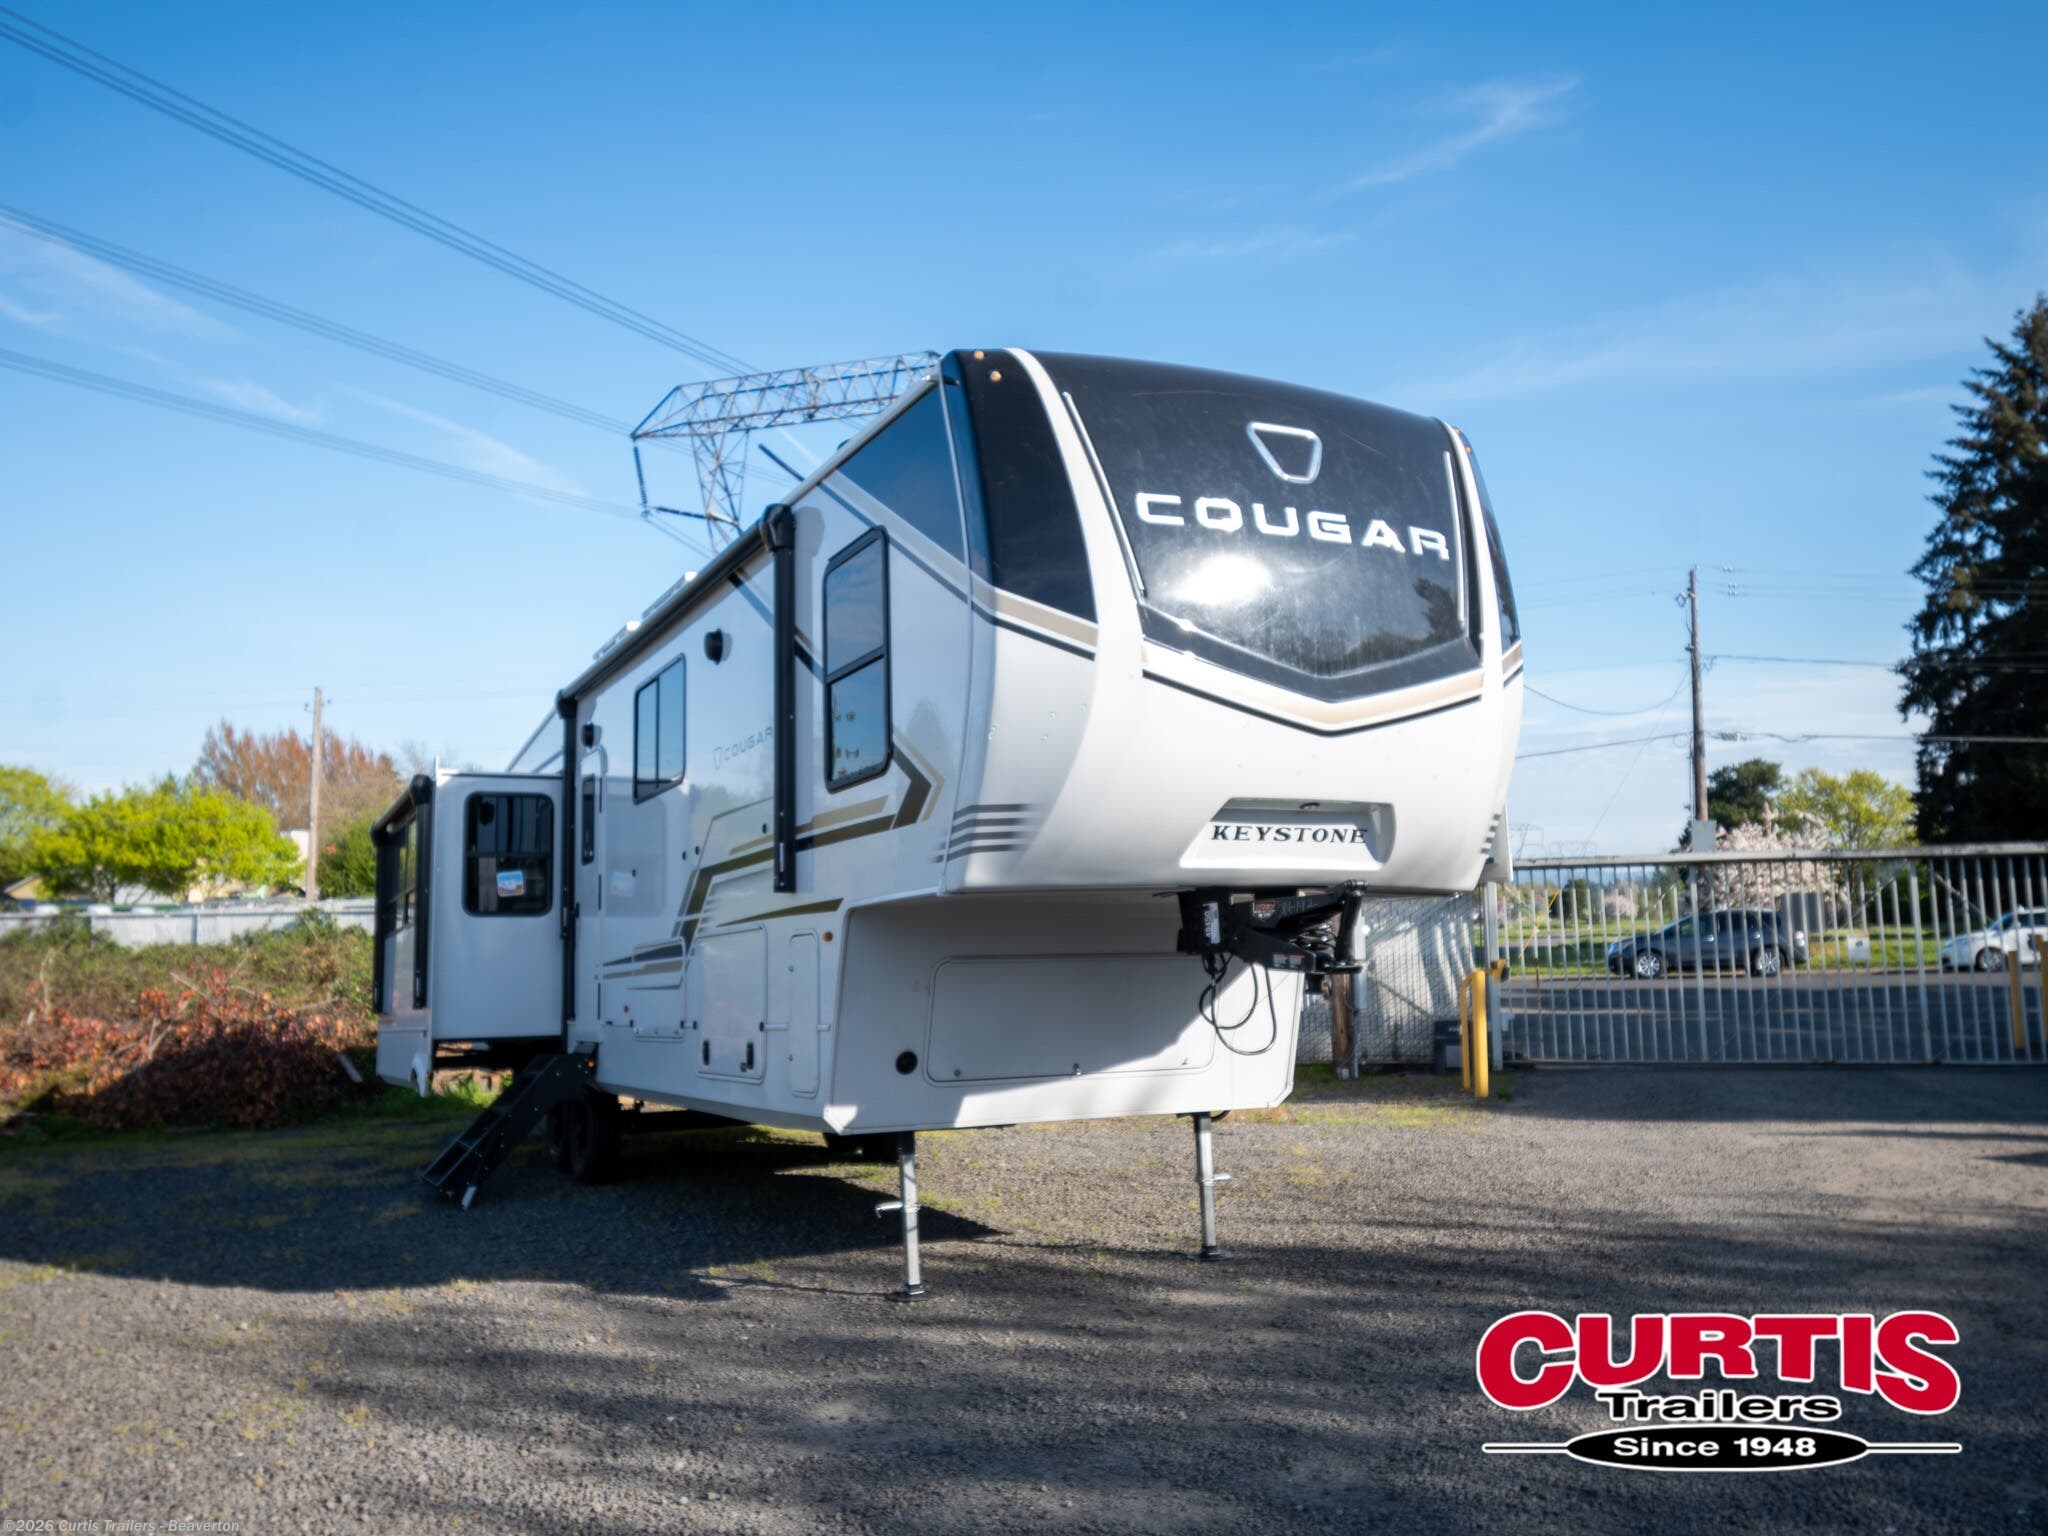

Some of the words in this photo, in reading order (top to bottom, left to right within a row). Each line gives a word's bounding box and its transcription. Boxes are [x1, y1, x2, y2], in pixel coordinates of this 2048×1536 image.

[1135, 491, 1450, 561] COUGAR
[724, 726, 773, 761] COUGAR
[1210, 824, 1368, 845] KEYSTONE
